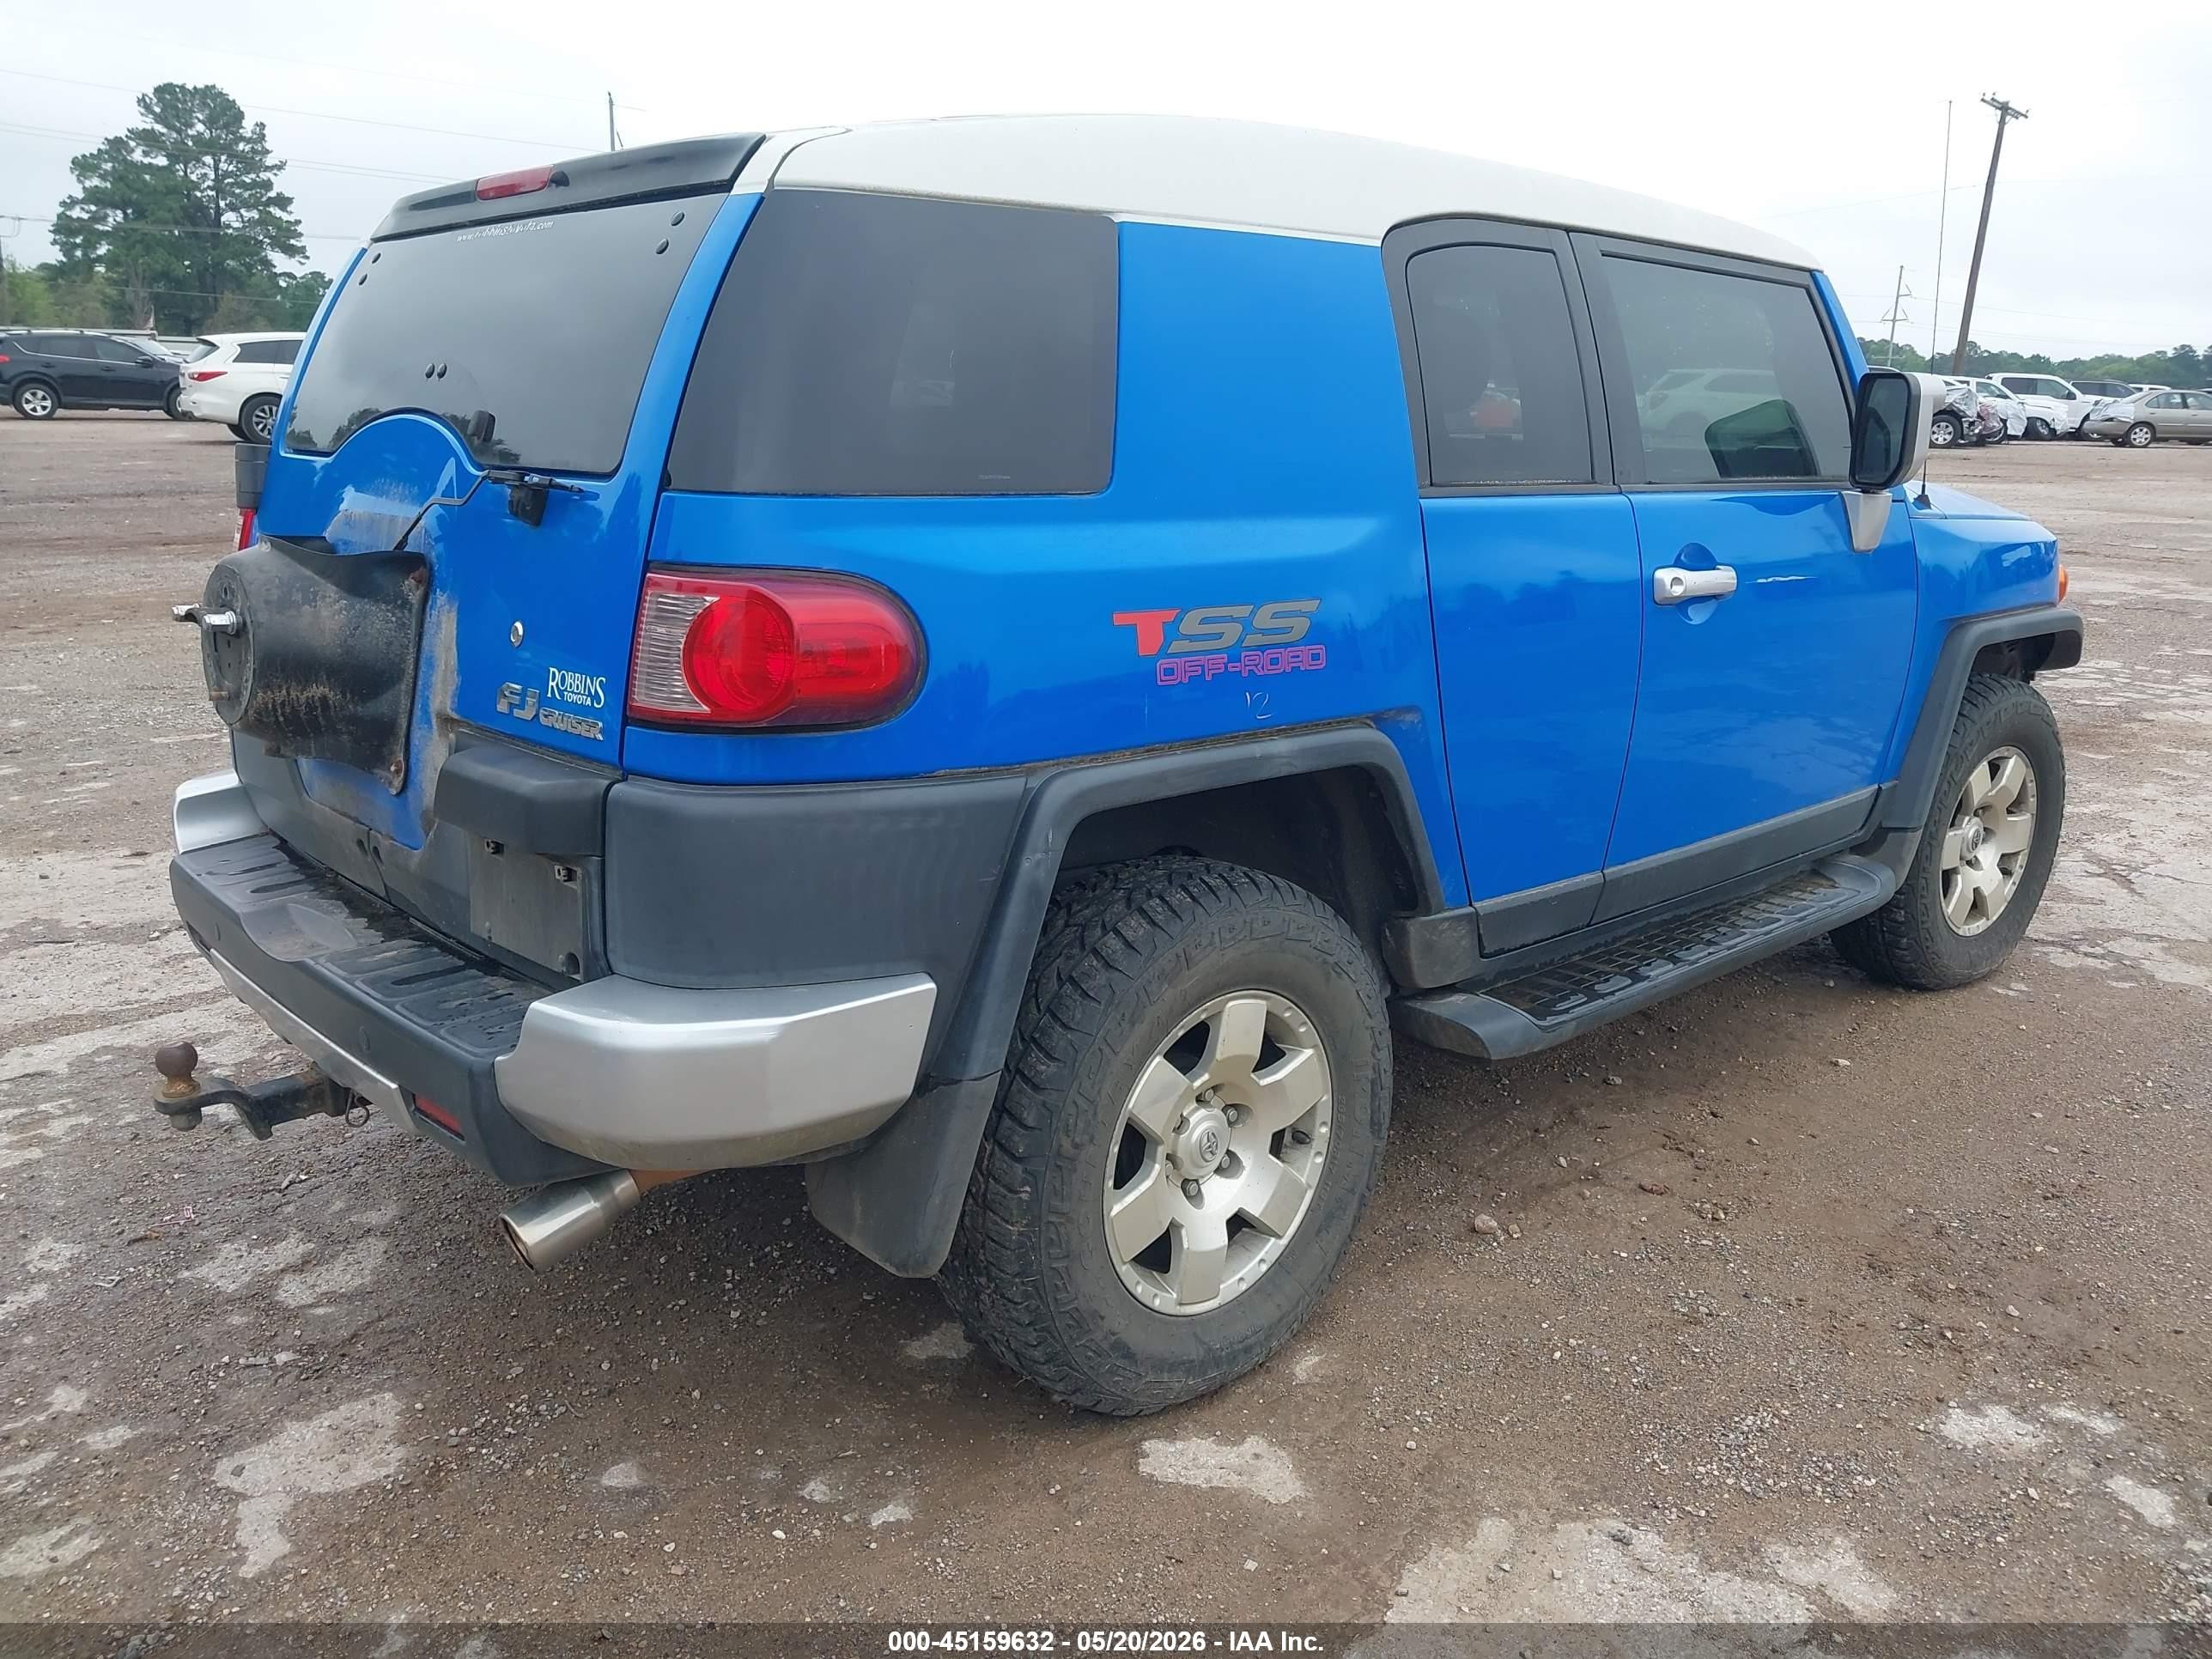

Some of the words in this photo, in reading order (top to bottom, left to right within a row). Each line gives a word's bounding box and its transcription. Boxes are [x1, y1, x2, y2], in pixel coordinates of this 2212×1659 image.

[1113, 599, 1322, 657] TSS
[1156, 645, 1327, 686] OFF-ROAD
[546, 666, 606, 708] ROBBINS
[563, 690, 592, 707] TOYOTA
[496, 682, 540, 721] FJ
[539, 708, 604, 741] CRUISER
